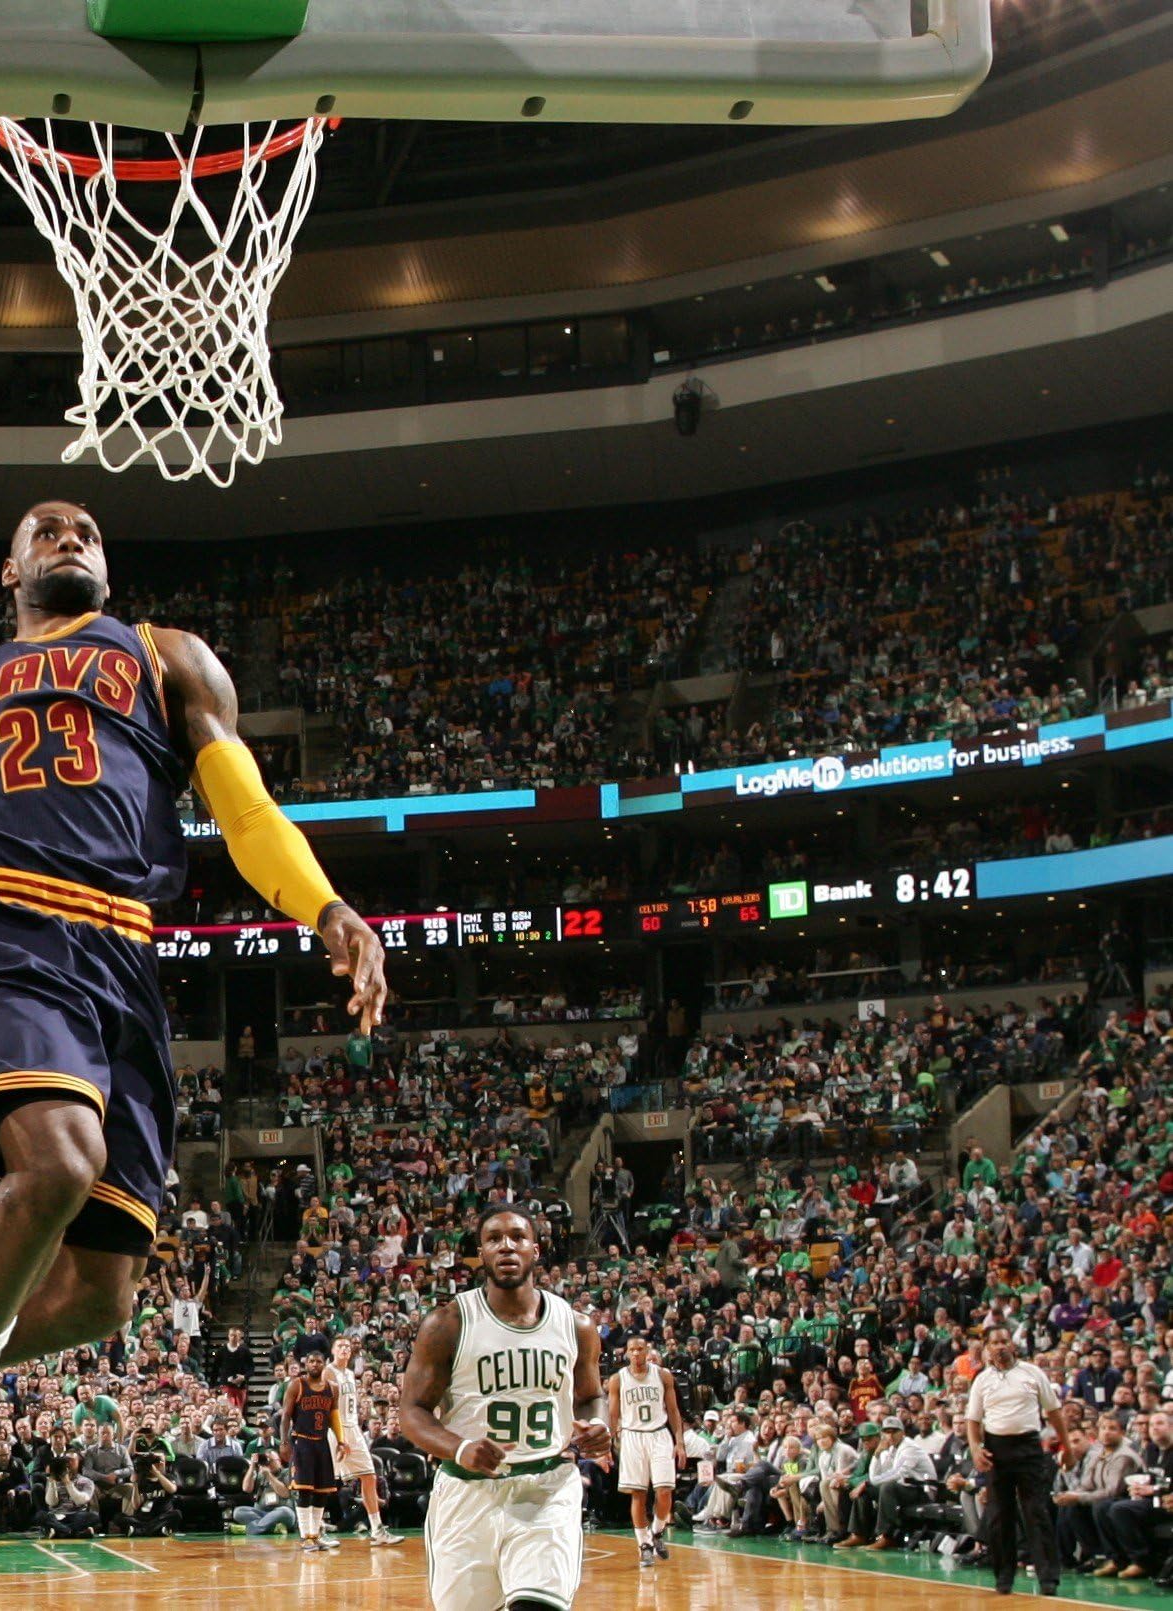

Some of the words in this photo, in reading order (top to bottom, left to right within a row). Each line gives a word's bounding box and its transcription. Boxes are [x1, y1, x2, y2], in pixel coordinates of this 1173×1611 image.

[850, 752, 945, 780] solutions
[947, 748, 979, 769] for
[983, 736, 1075, 764] business.
[896, 868, 970, 903] 8:42
[773, 886, 804, 912] TD
[813, 880, 873, 903] Bank
[687, 898, 717, 913] 7:58
[739, 906, 759, 921] 65
[382, 920, 406, 931] AST
[424, 918, 447, 930] REB
[463, 923, 483, 933] MIL
[512, 921, 531, 931] NOP
[564, 909, 602, 936] 22
[642, 917, 661, 931] 60
[175, 931, 191, 941] FG
[240, 928, 263, 939] 3PT
[385, 932, 407, 947] 11
[426, 930, 448, 946] 29
[545, 930, 551, 940] 2
[156, 942, 211, 958] 23/49
[234, 938, 279, 956] 7/19
[300, 937, 311, 952] 8
[648, 1114, 664, 1125] EXIT
[263, 1132, 278, 1142] EXIT
[477, 1348, 567, 1395] CELTICS
[625, 1386, 659, 1405] CELTICS
[315, 1412, 323, 1430] 2
[639, 1405, 651, 1422] 0
[487, 1401, 553, 1449] 99
